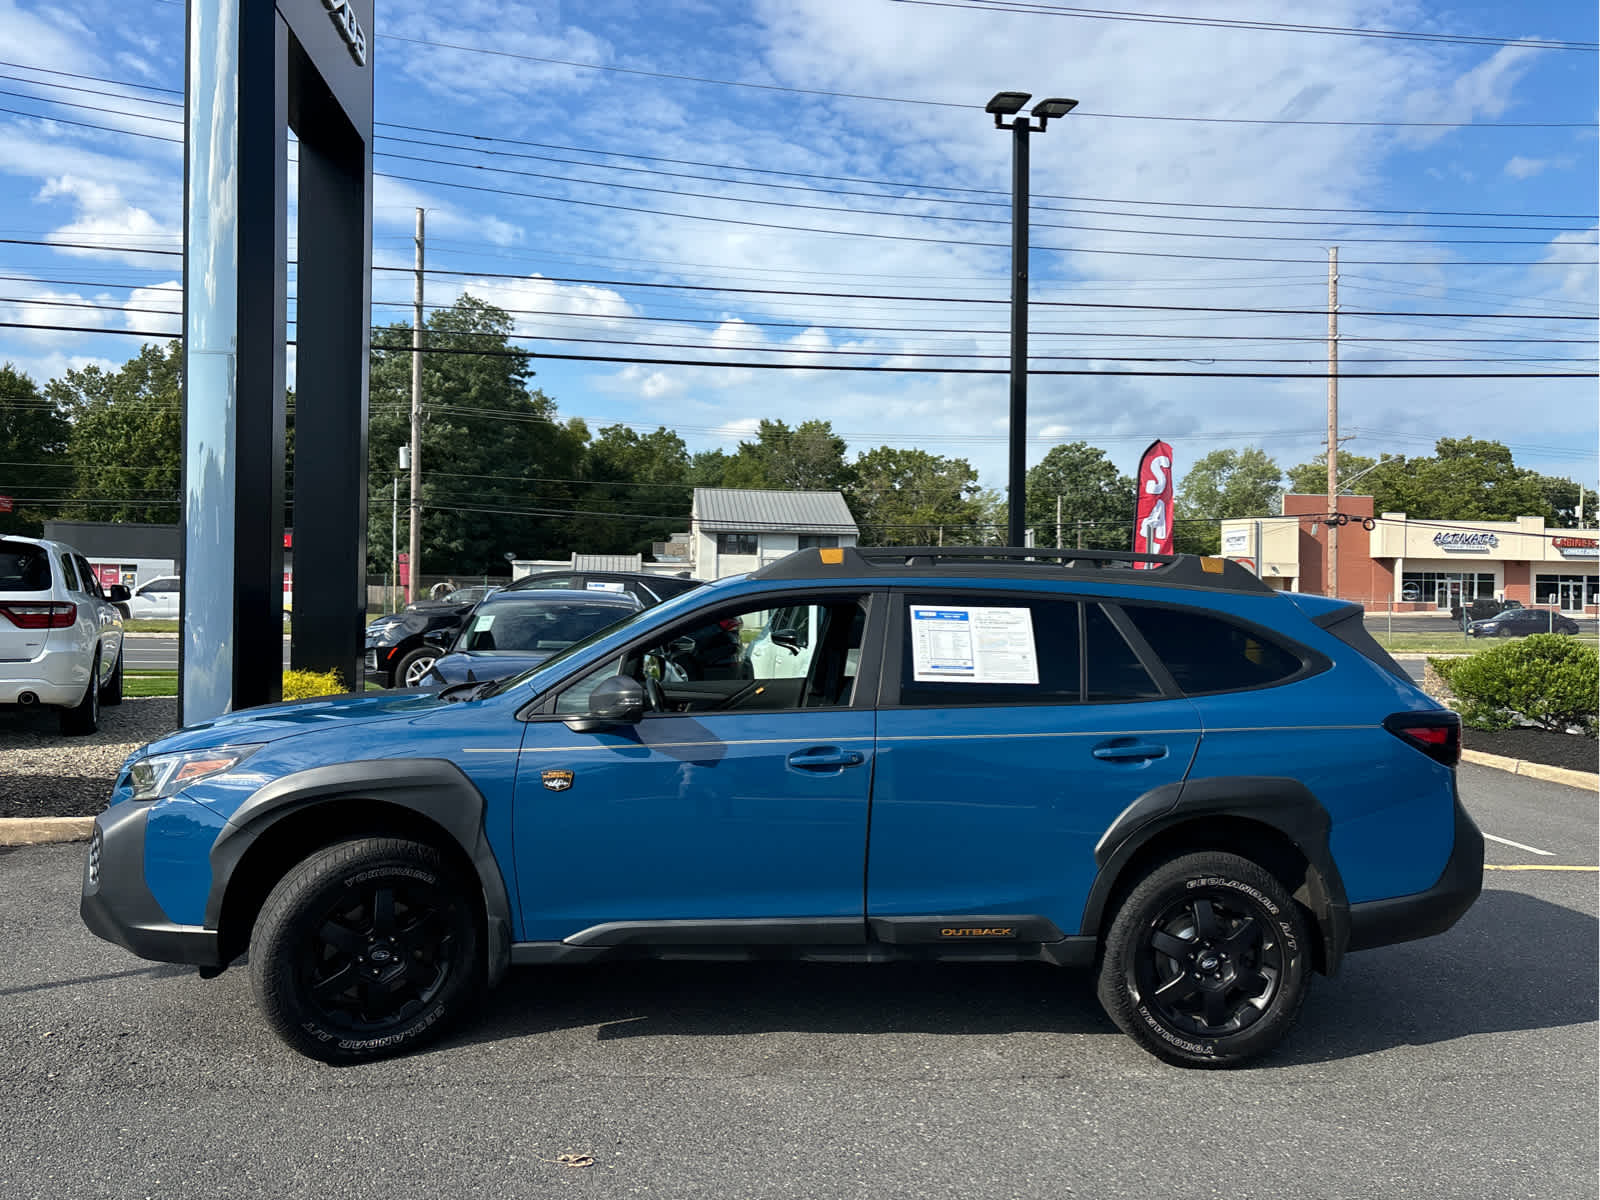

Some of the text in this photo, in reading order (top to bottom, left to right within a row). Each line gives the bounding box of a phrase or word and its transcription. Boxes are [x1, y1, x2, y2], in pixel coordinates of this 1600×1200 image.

[1433, 532, 1496, 545] ACTIVATE
[941, 928, 1012, 937] OUTBACK
[1186, 877, 1298, 951] GEOLANDAR A/T
[338, 1003, 446, 1049] GEOLANDAR
[1137, 1005, 1215, 1055] YOKOHAMA
